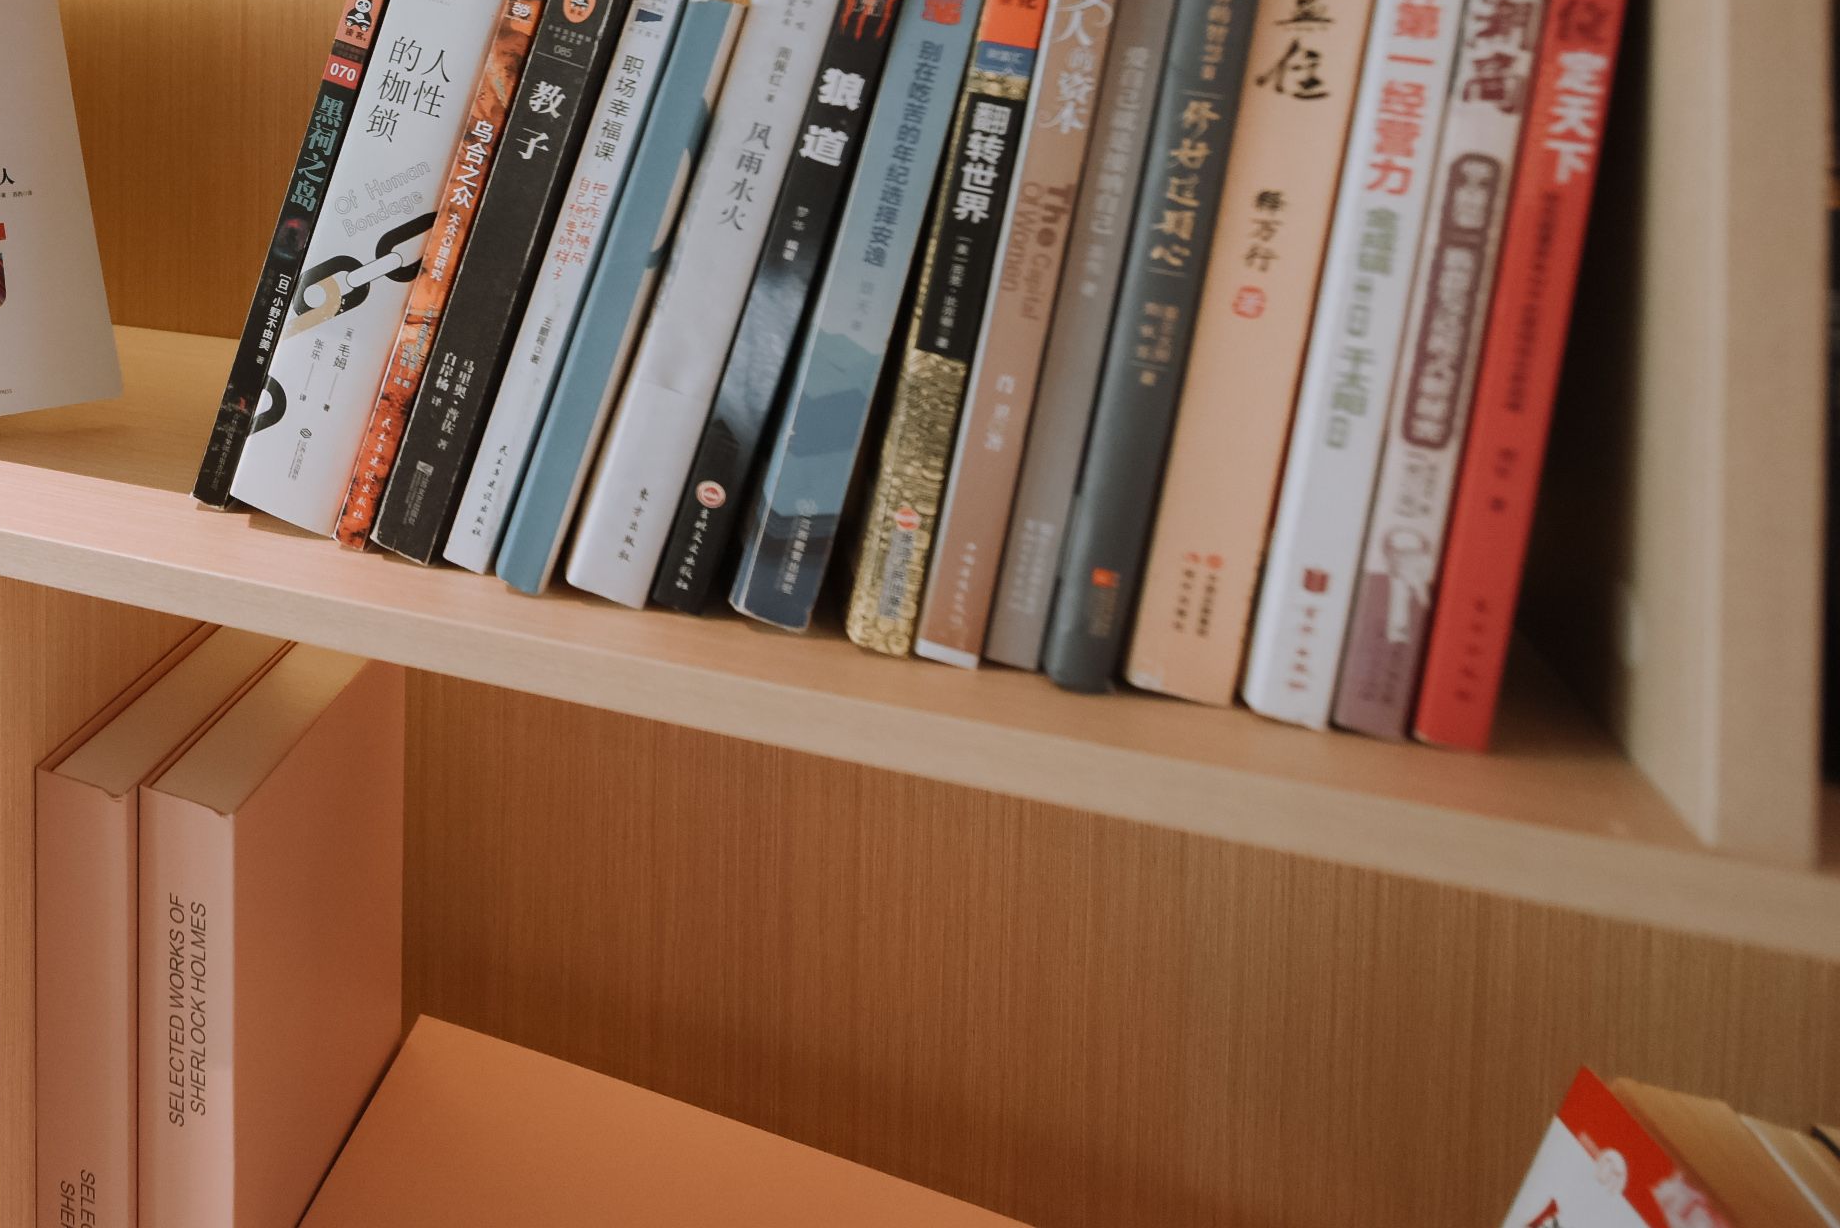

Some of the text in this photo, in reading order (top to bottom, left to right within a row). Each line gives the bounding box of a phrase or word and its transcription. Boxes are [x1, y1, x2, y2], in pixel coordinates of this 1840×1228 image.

[329, 62, 357, 82] 070
[366, 36, 423, 143] 的枷锁
[412, 48, 451, 119] 人性
[553, 44, 573, 59] 085
[515, 80, 567, 161] 教子
[594, 54, 645, 162] 职场幸福课
[798, 67, 866, 168] 狼道
[290, 94, 344, 212] 黑祠之岛
[334, 161, 430, 215] Of Human
[450, 120, 494, 210] 乌合之众
[717, 121, 772, 233] 风雨水火
[864, 40, 944, 269] 别在吃苦的年纪选择安逸
[951, 101, 1012, 225] 翻转世界
[342, 189, 424, 238] Bondage
[429, 212, 461, 282] 大众心理研究
[552, 175, 592, 281] 自己想要的样子
[570, 181, 610, 267] 把工作折腾成
[258, 295, 285, 352] 小野不由美
[310, 338, 325, 361] 张乐
[332, 343, 352, 372] 毛姆
[169, 892, 185, 1128] SELECTED WORKS OF
[189, 901, 206, 1116] SHERLOCK HOLMES
